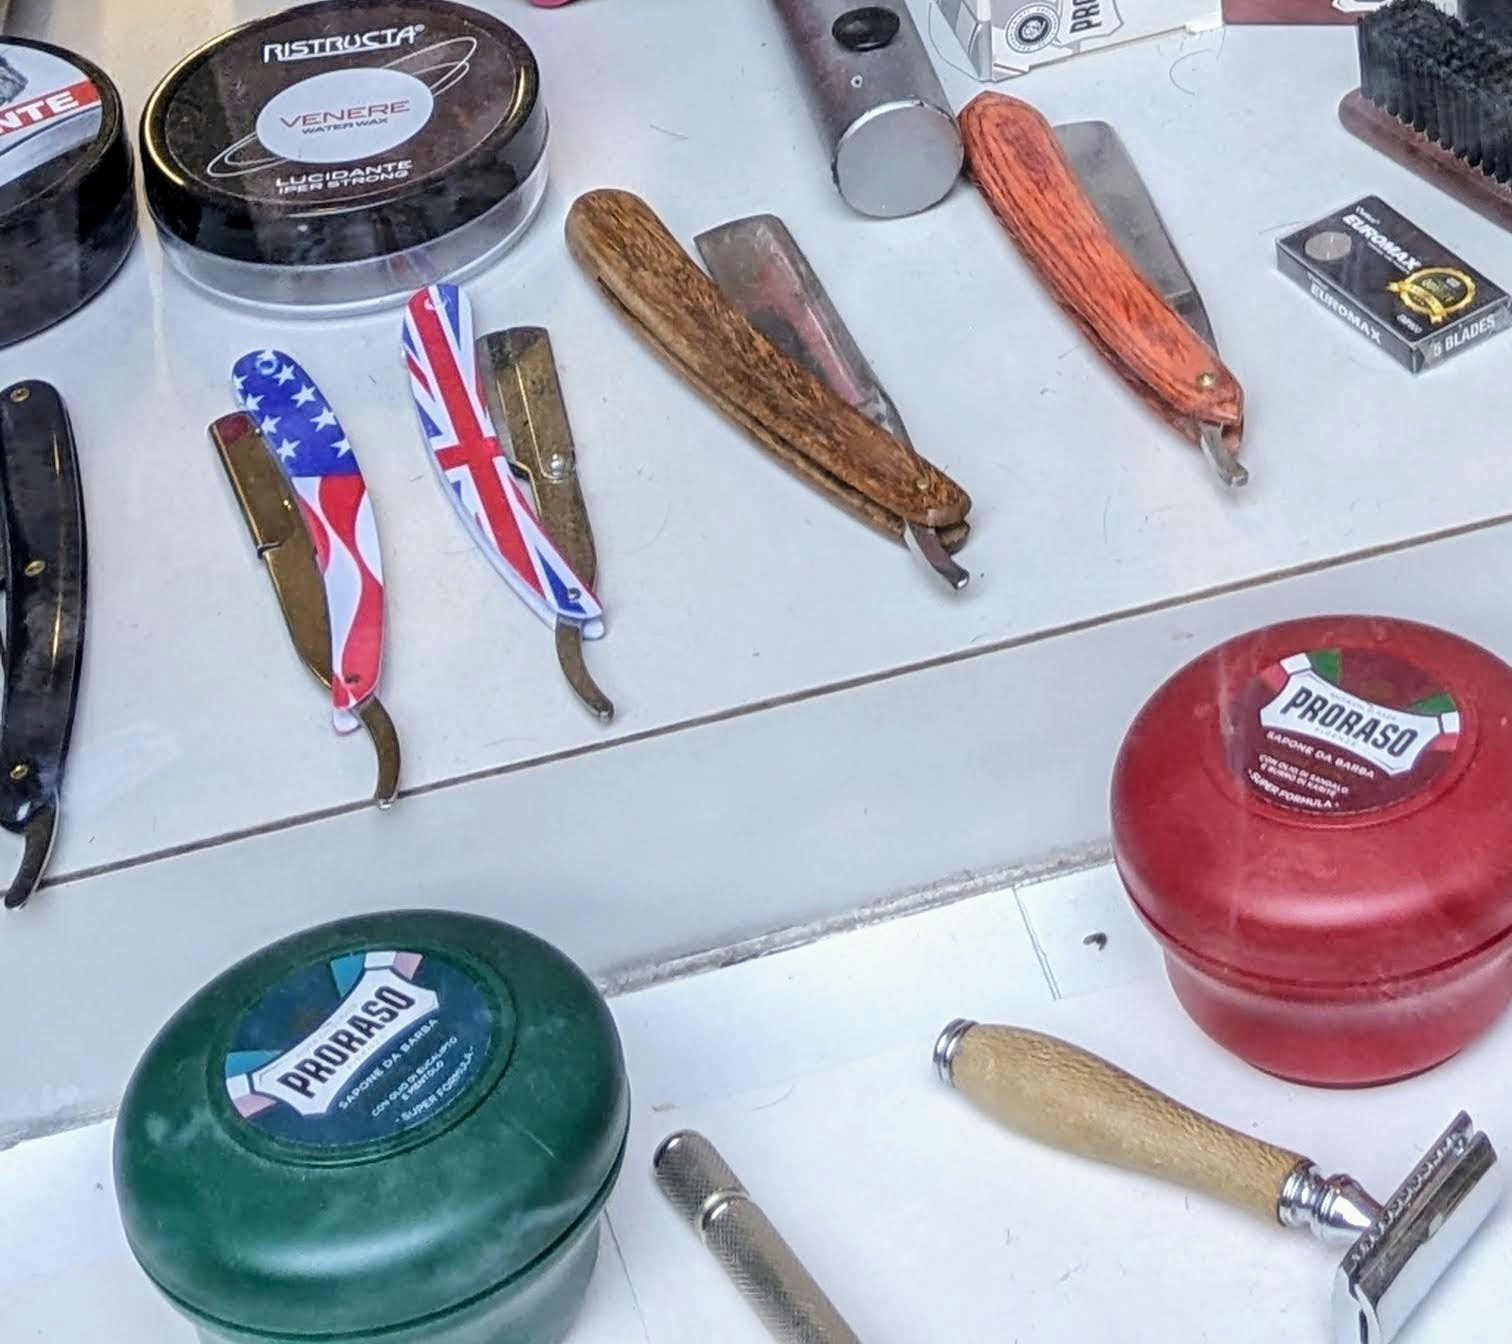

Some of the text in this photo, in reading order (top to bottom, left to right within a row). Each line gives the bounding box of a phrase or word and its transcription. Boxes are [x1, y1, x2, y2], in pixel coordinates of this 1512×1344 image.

[280, 100, 411, 128] VENERE
[302, 117, 389, 135] WATER WAX
[275, 160, 413, 187] LUCIDANTE
[279, 169, 409, 194] IPER STRONG
[1342, 213, 1423, 272] EUROMAX
[1310, 280, 1382, 345] EUROMAX
[1445, 313, 1496, 352] BLADES
[1279, 686, 1418, 757] PRORASO
[1266, 731, 1375, 780] SAPONE DA BARBA
[1279, 789, 1332, 809] FORMULA
[276, 985, 416, 1099] PRORASO
[338, 1018, 439, 1110] SAPONE DA BARBA
